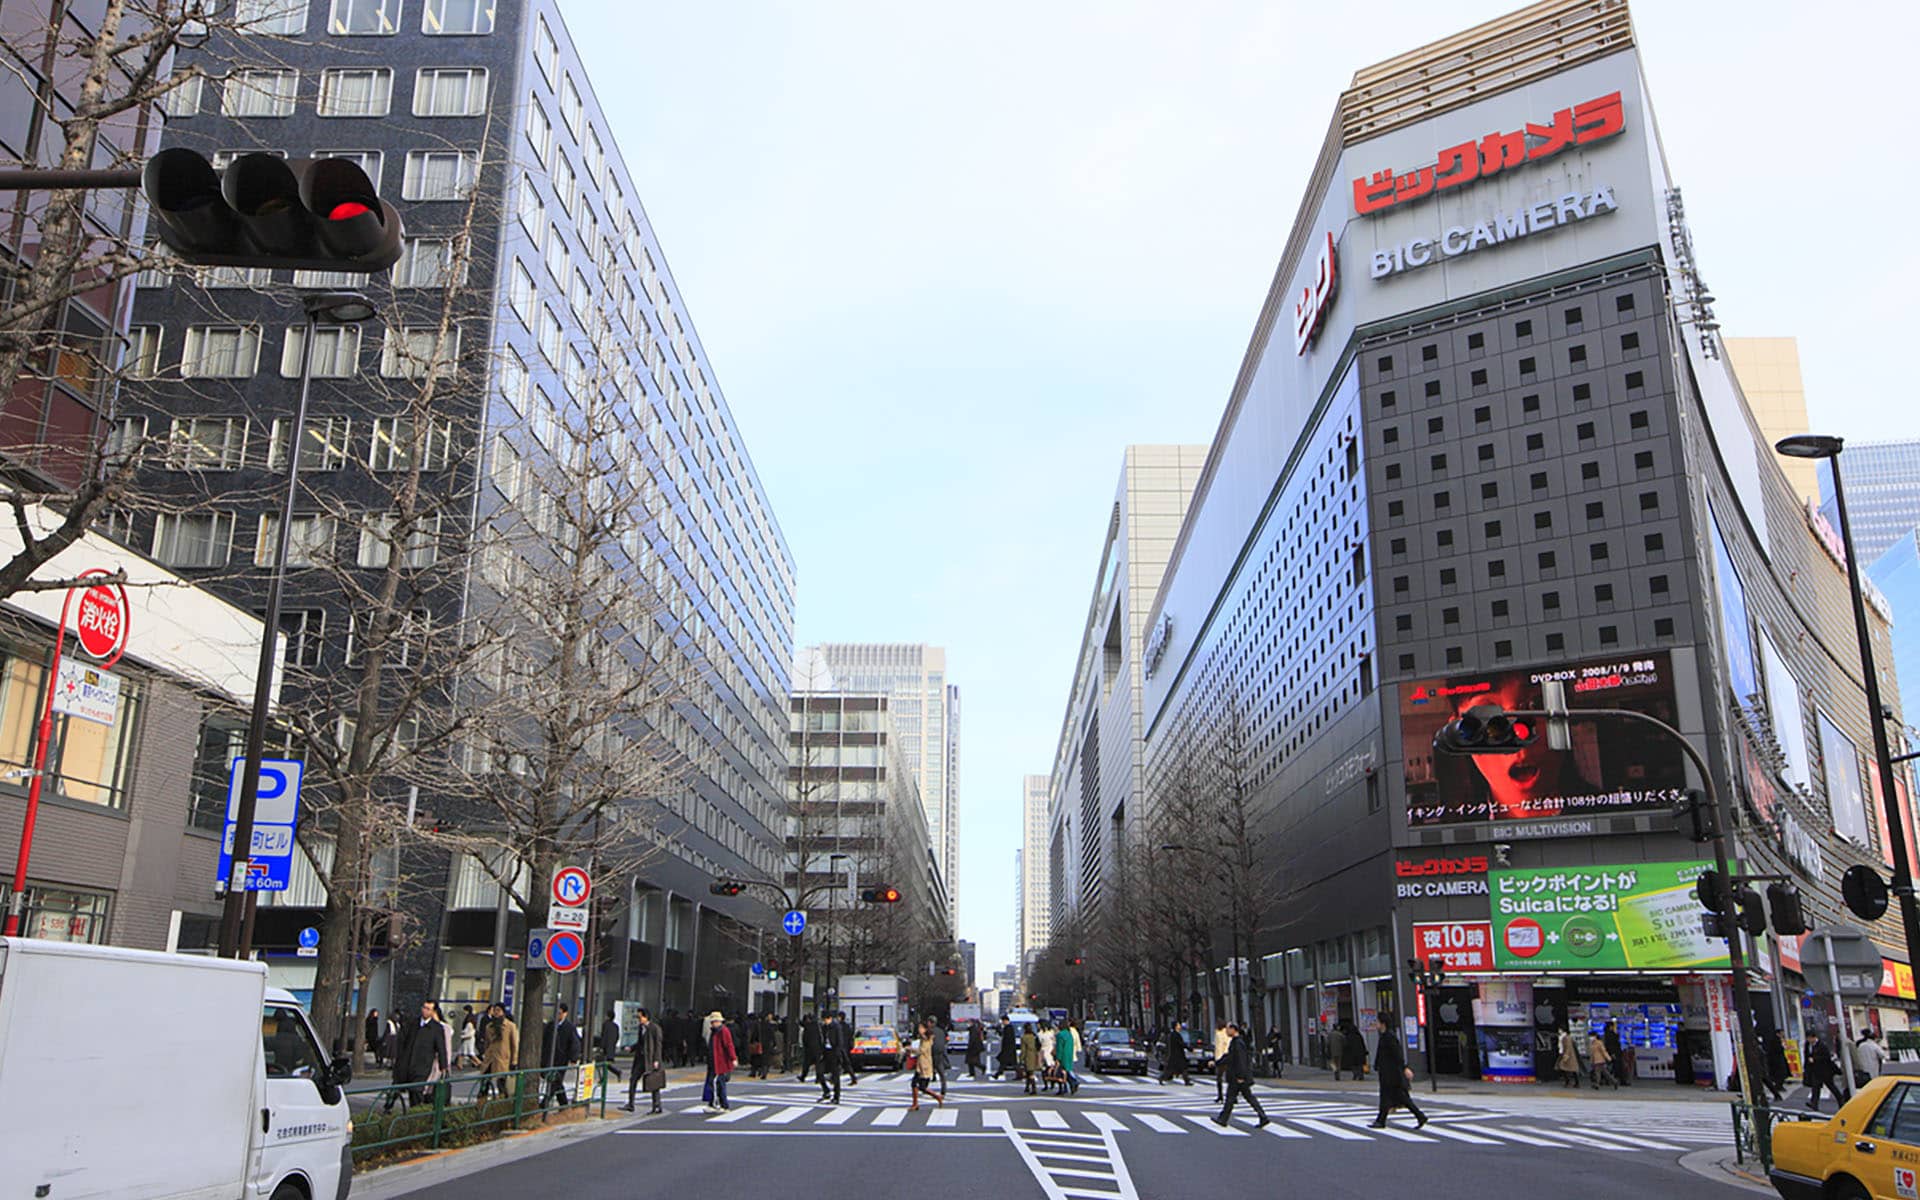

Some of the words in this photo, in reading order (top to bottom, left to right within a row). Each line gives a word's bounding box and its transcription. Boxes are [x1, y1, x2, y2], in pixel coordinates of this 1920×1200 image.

[1353, 91, 1625, 214] ビックカメラ
[1370, 242, 1432, 280] BIC
[1441, 185, 1618, 257] CAMERA
[80, 599, 118, 640] 消火栓
[255, 768, 287, 799] P
[1493, 827, 1513, 839] BIC
[1516, 822, 1592, 837] MULTIVISION
[1395, 856, 1489, 877] ビックカメラ
[1397, 883, 1422, 897] BIC
[1425, 881, 1490, 896] CAMERA
[1499, 871, 1636, 893] ビックポイントが
[1500, 894, 1617, 913] Suicaになる!
[1423, 925, 1485, 948] 夜10時
